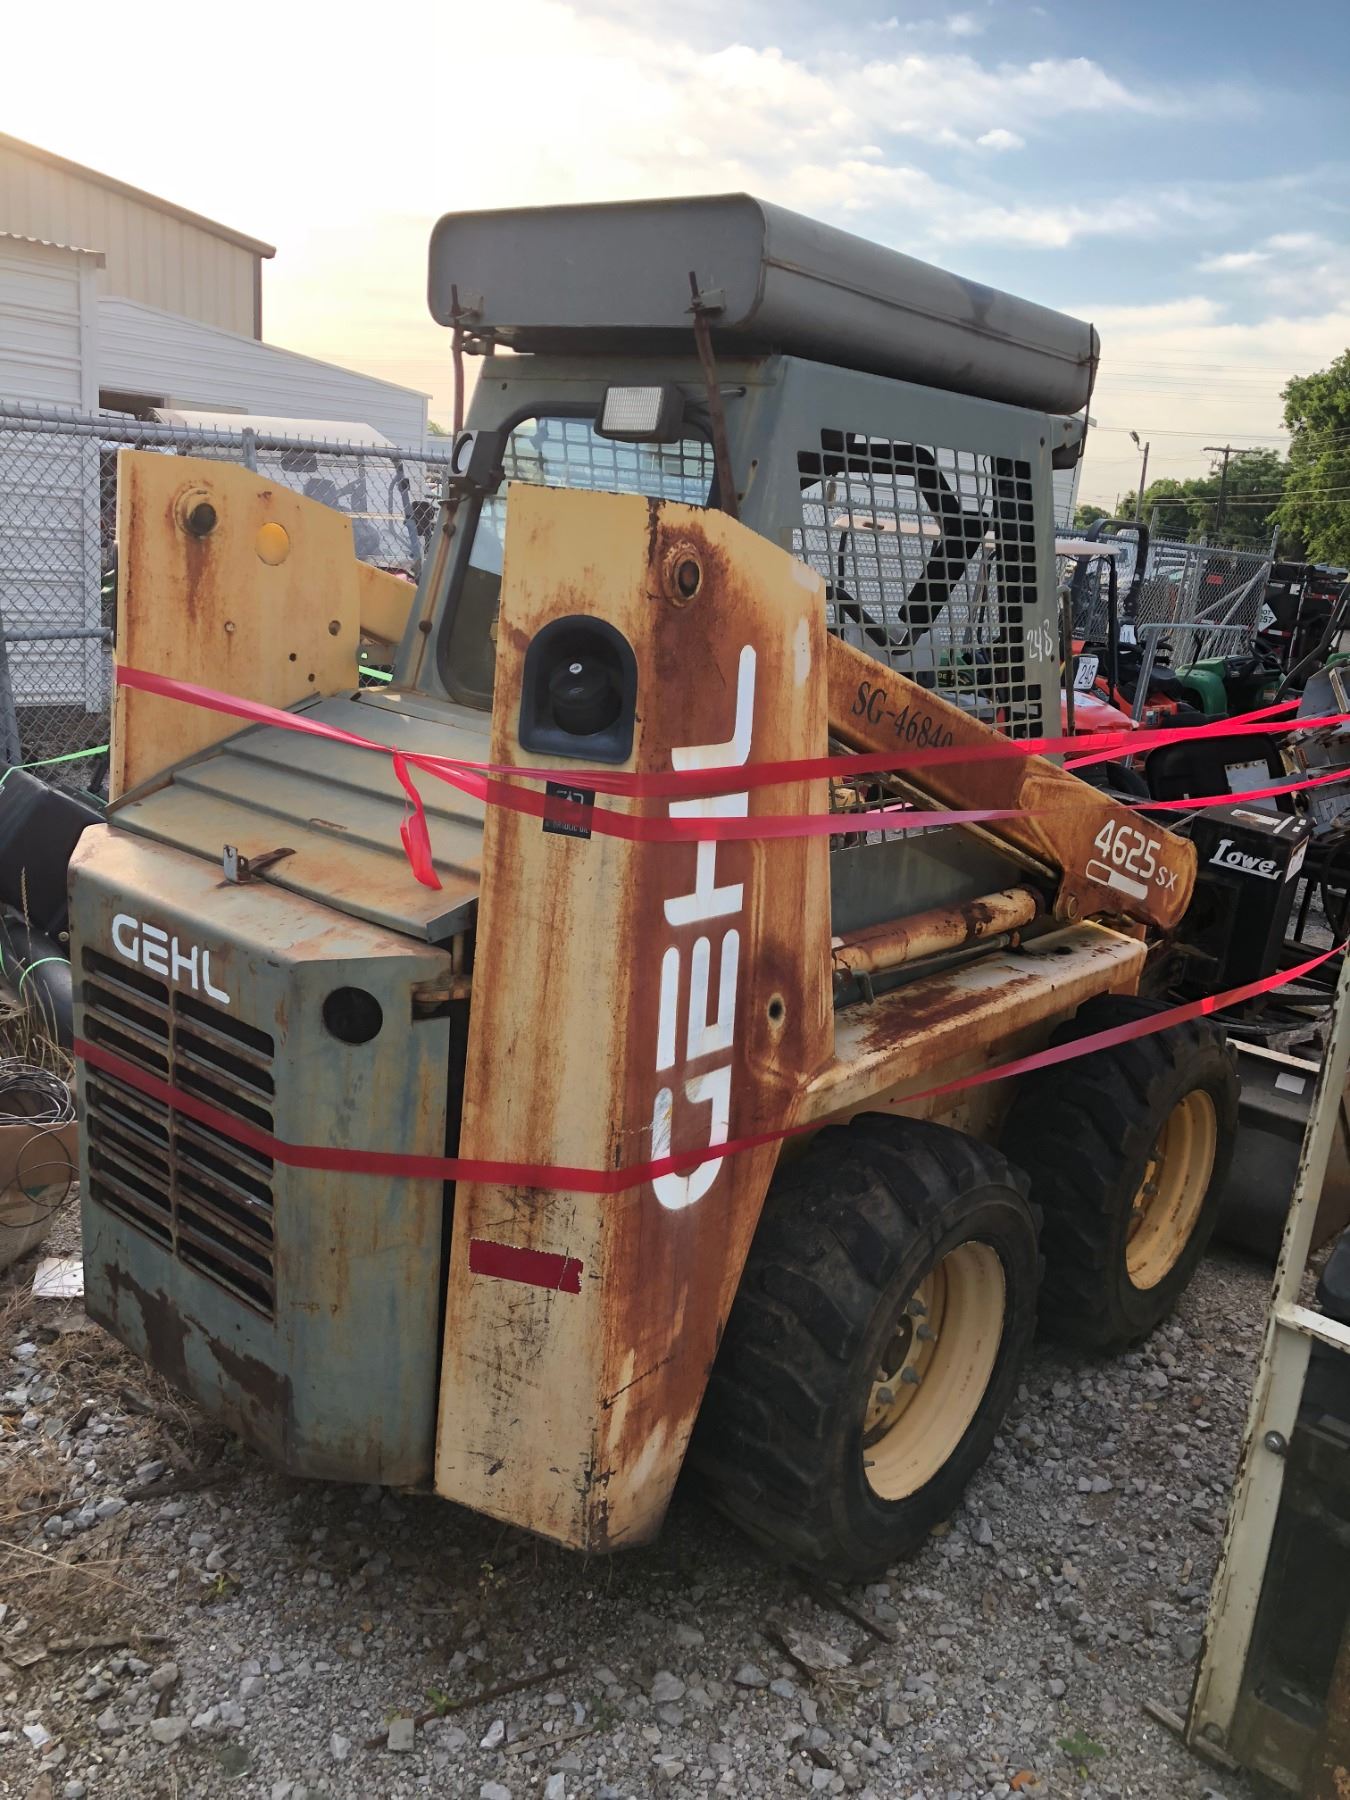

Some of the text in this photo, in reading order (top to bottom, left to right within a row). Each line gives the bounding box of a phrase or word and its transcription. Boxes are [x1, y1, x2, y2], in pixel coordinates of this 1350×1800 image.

[1026, 618, 1053, 662] 248
[1094, 819, 1178, 891] 4625 SX
[1209, 838, 1283, 880] Lowe
[111, 913, 230, 1004] GEHL
[652, 644, 757, 1210] GEHL
